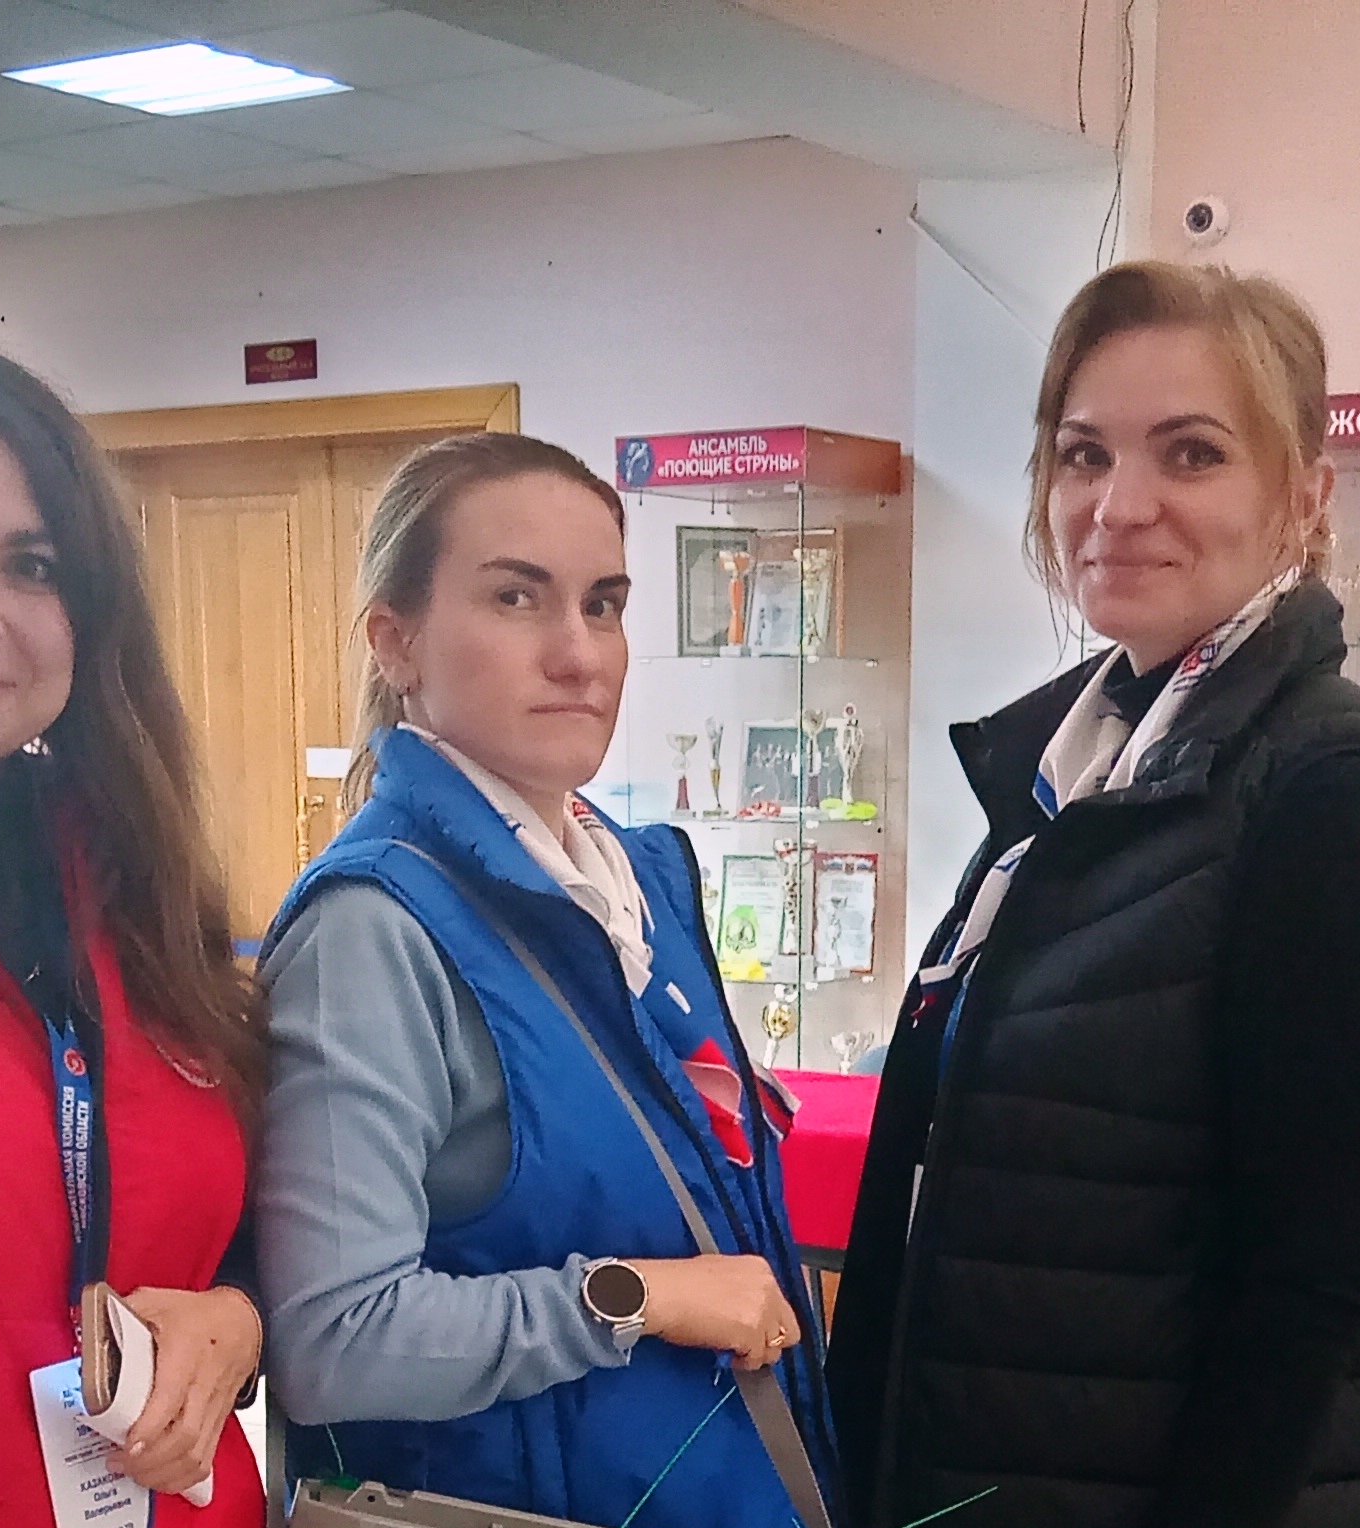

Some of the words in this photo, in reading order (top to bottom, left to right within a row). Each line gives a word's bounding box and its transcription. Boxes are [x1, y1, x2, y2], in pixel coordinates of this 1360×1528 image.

[687, 435, 768, 458] АНСАМБЛЬ
[657, 455, 733, 479] «ПОЮЩИЕ
[734, 453, 800, 474] СТРУНЫ»
[61, 1085, 75, 1148] КОМИССИЯ
[75, 1100, 90, 1149] ОБЛАСТИ
